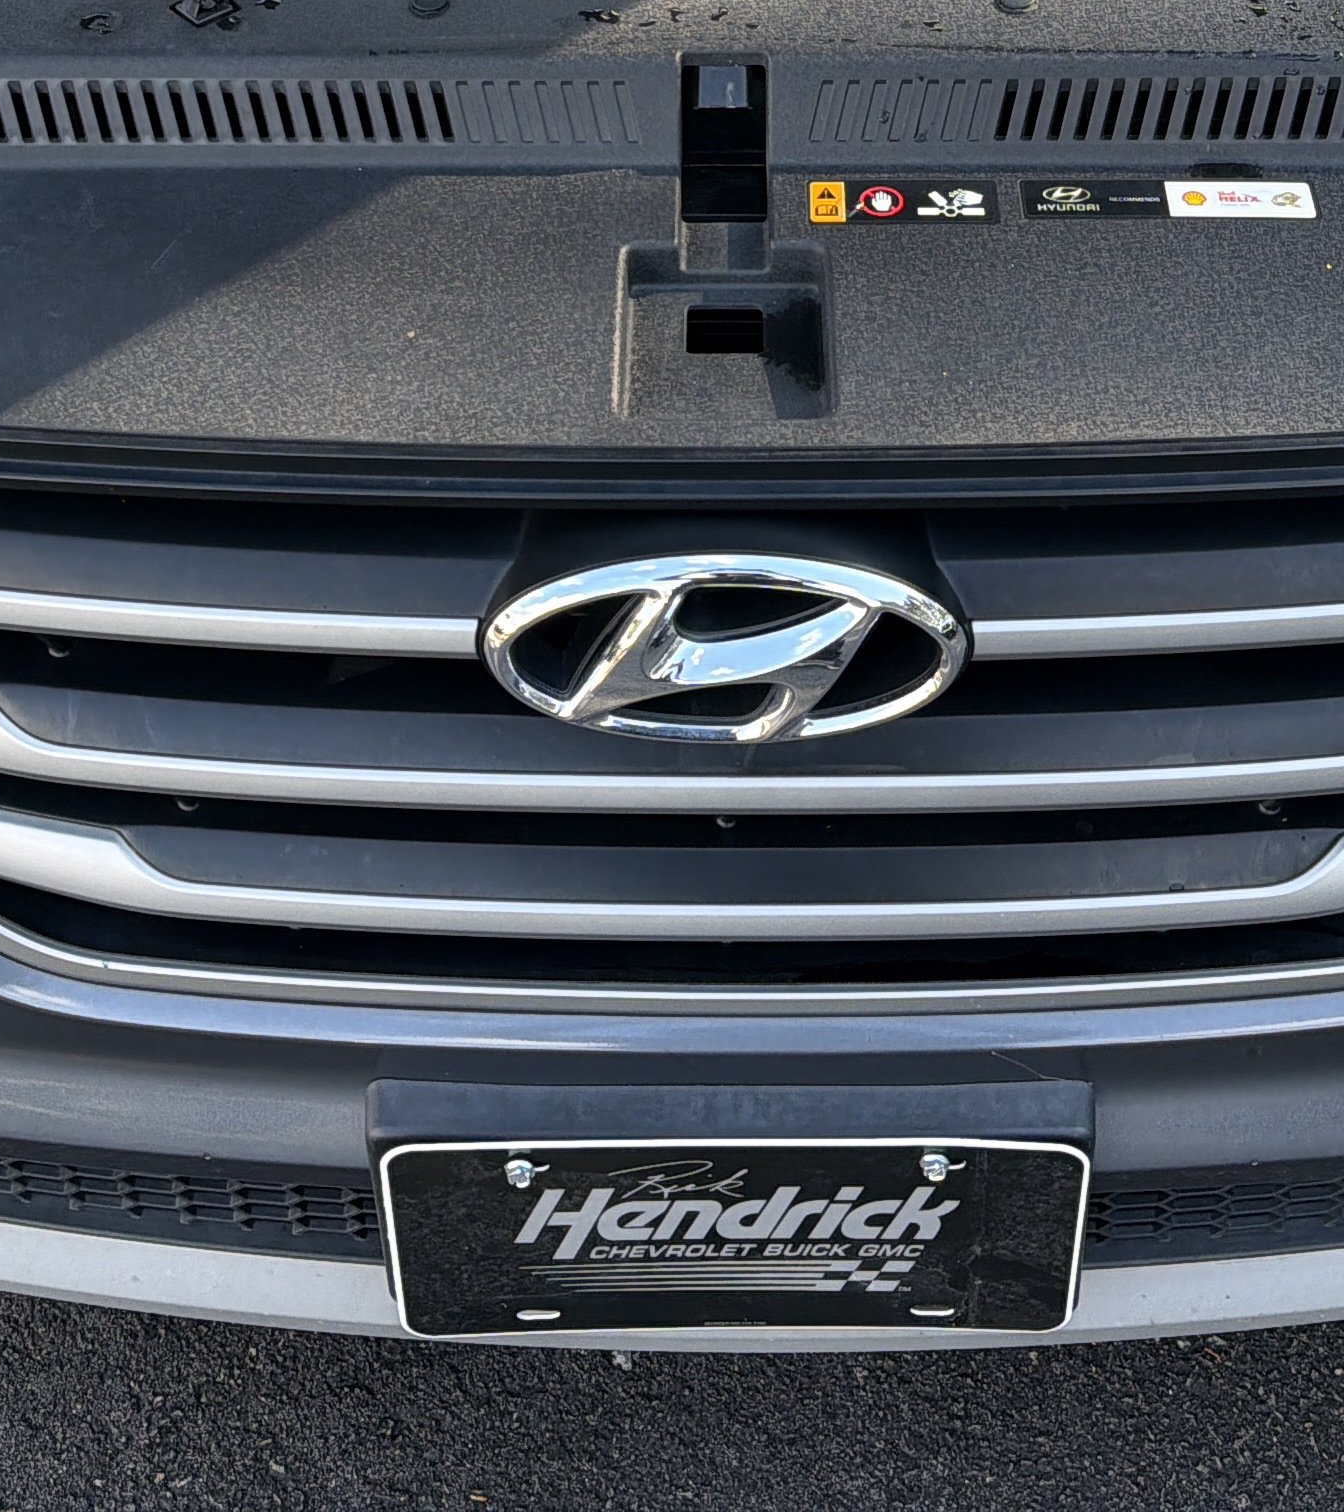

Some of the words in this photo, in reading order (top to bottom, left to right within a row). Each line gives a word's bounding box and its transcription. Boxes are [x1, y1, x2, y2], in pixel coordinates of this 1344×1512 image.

[1037, 203, 1101, 212] HYUNDAI
[513, 1185, 961, 1260] Hendrick
[589, 1244, 758, 1260] CHEVROLET
[763, 1243, 851, 1258] BUICK
[858, 1244, 925, 1258] GMC
